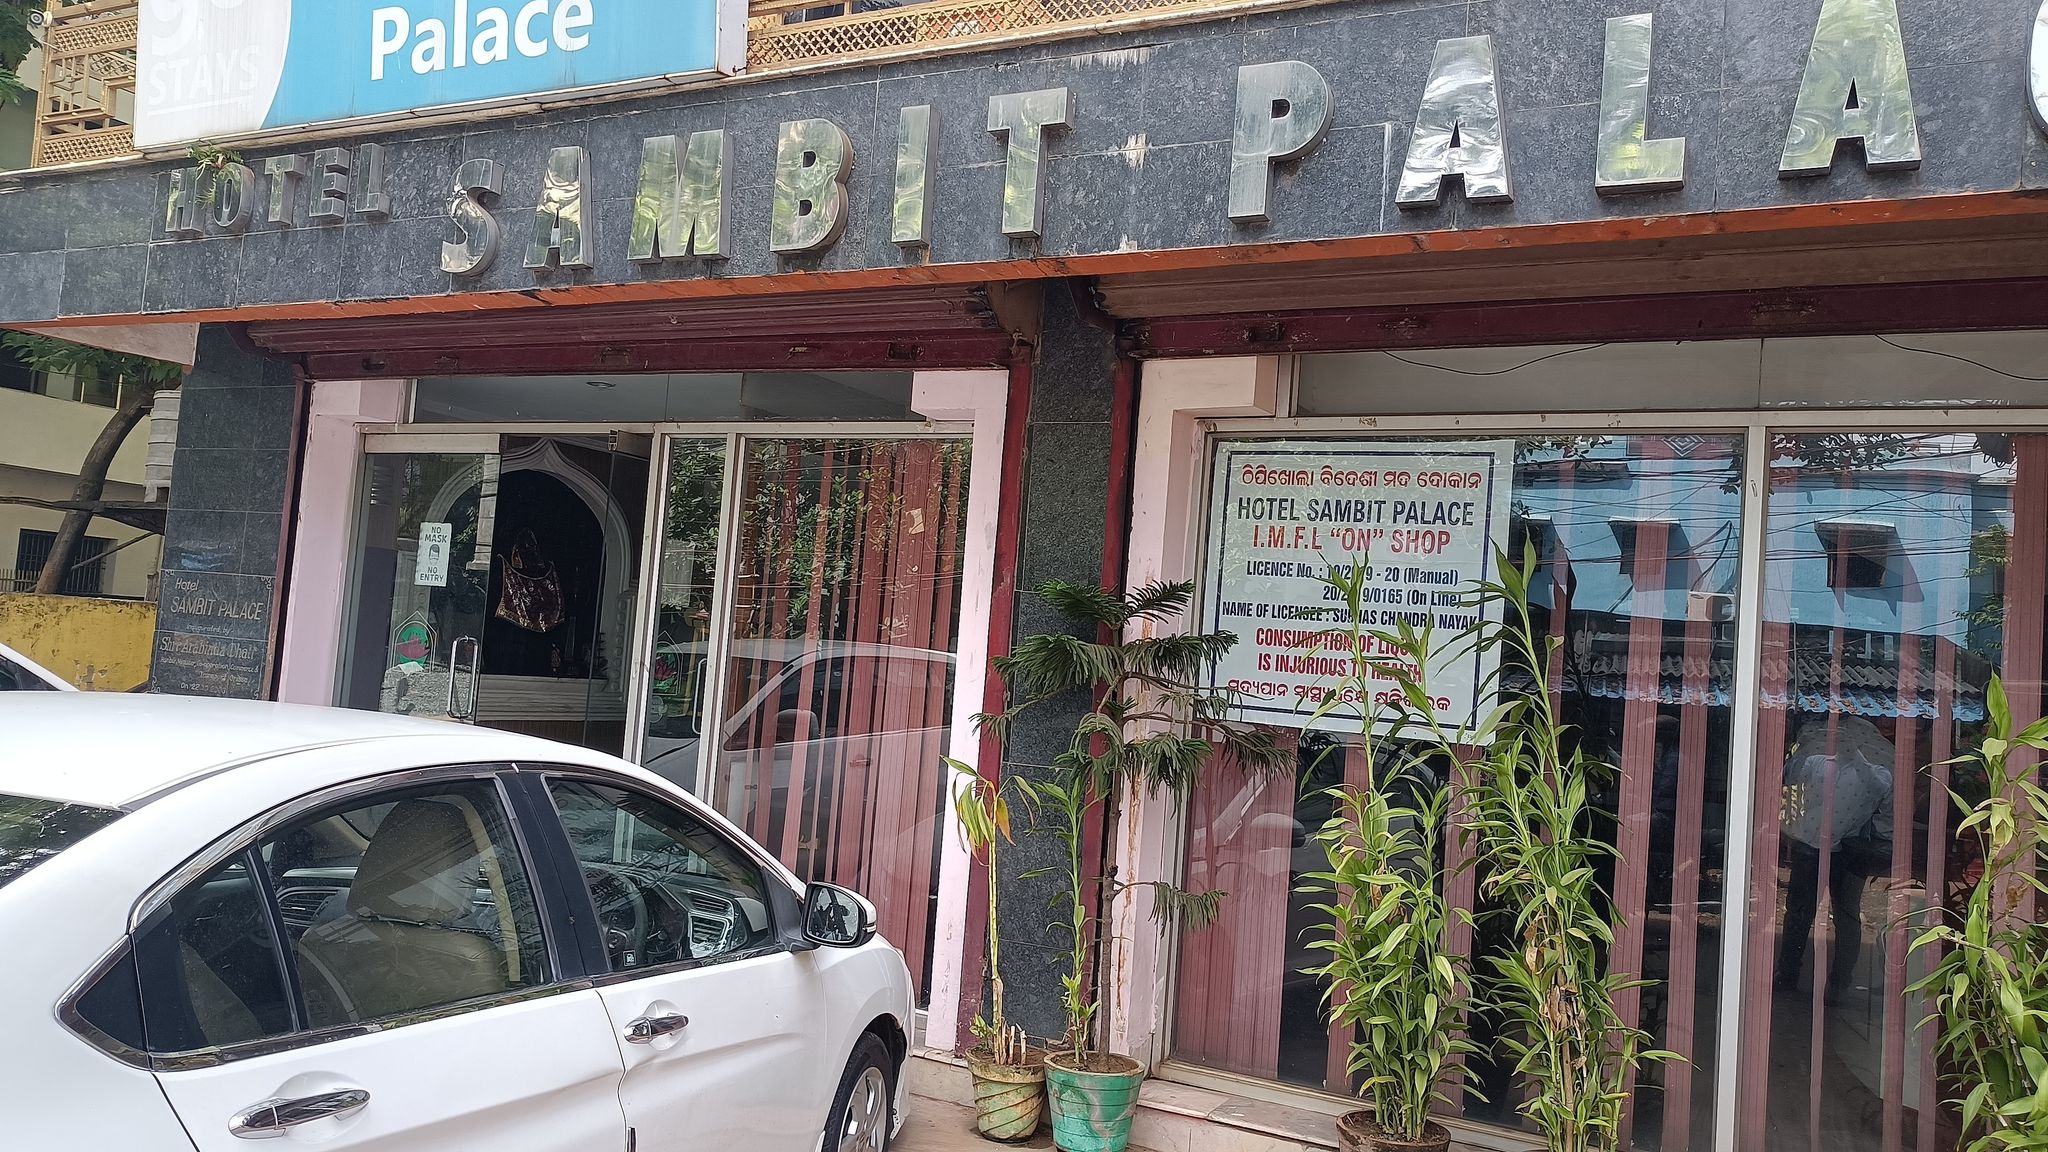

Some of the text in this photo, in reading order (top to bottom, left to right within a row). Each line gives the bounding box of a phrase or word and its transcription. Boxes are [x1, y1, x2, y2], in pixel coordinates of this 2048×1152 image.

[370, 0, 595, 80] Palace
[148, 45, 260, 105] STAYS
[165, 0, 2048, 277] HOTEL SAMBIT PALA
[1417, 471, 1482, 489] ଦୋକାନ
[1238, 497, 1475, 526] HOTEL SAMBIT PALACE
[424, 534, 448, 543] MASK
[431, 526, 442, 534] NO
[1253, 525, 1323, 550] I.M.F.L
[1391, 530, 1451, 554] SHOP
[420, 573, 445, 582] ENTRY
[427, 566, 438, 574] NO
[1246, 560, 1294, 577] LICENCE
[1327, 564, 1373, 581] 10/29
[1384, 566, 1400, 582] 20
[1403, 567, 1459, 587] (Manual)
[175, 577, 200, 591] Hotel
[170, 596, 264, 620] SAMBIT PALACE
[1407, 589, 1427, 607] (On
[1222, 601, 1253, 617] NAME
[1256, 603, 1270, 618] OF
[1271, 604, 1323, 622] LICENSEE
[1255, 627, 1353, 651] CONSUMPTION
[1358, 634, 1375, 653] OF
[1257, 652, 1272, 671] IS
[1274, 654, 1347, 677] INJURIOUS
